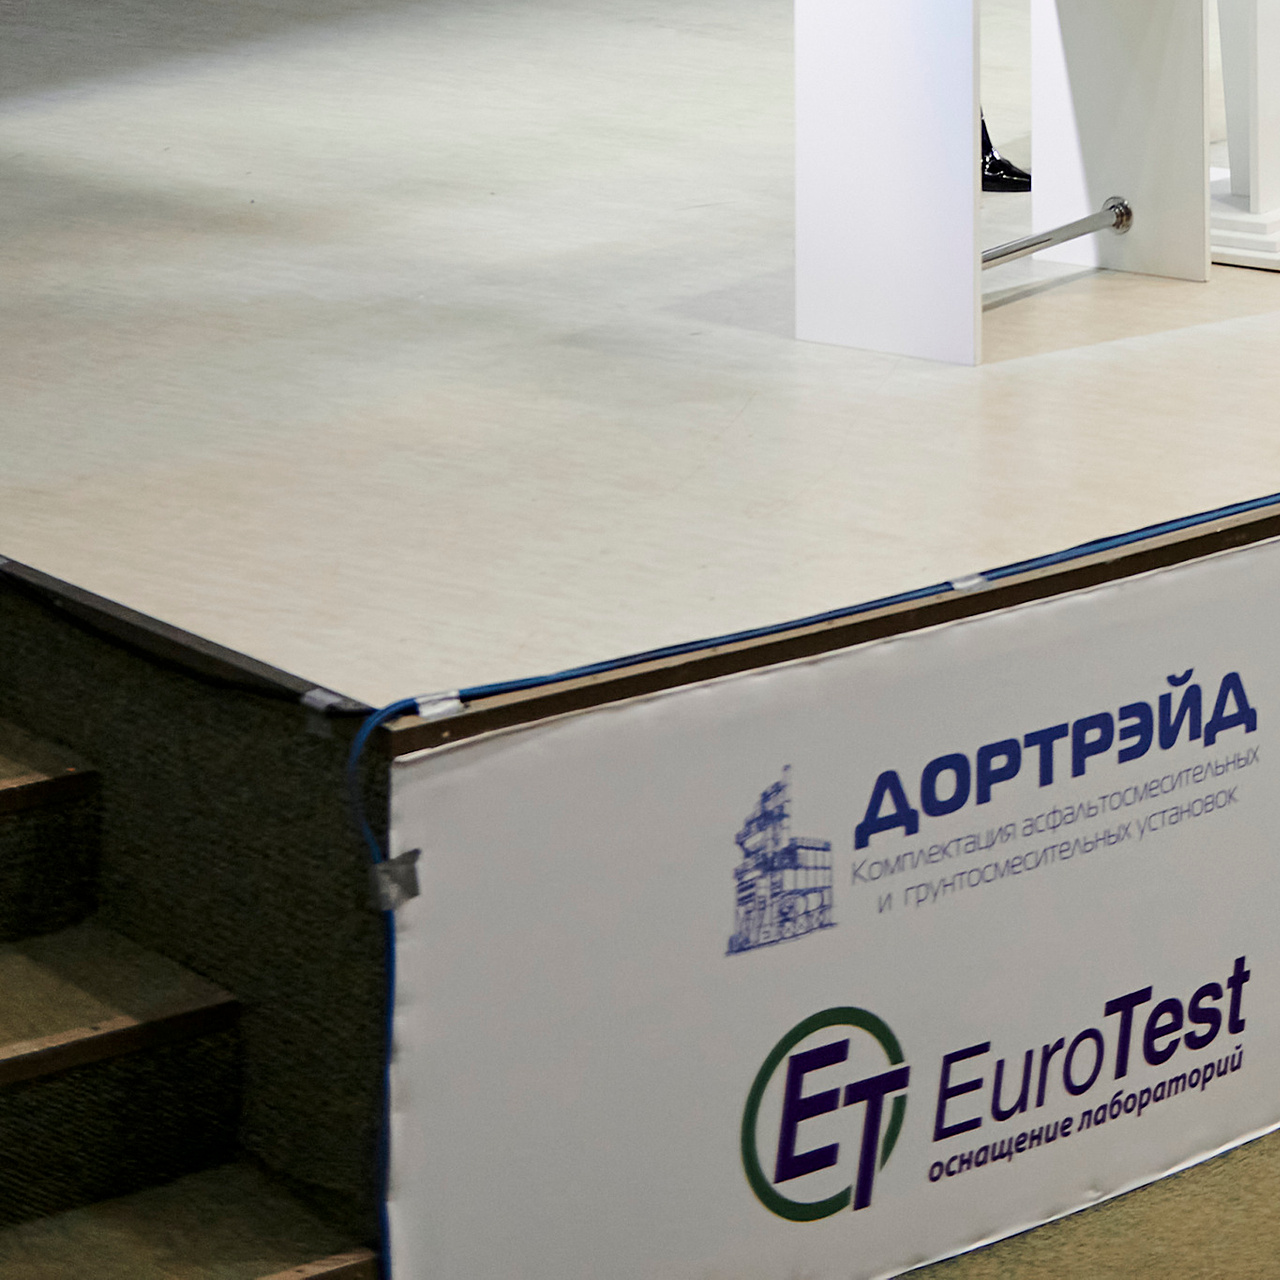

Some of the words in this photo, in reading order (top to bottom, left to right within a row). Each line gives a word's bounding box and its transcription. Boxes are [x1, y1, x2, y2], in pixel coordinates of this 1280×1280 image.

[851, 823, 1017, 886] Комплектация
[1021, 744, 1260, 838] асфальтосмесительных
[853, 667, 1258, 850] ДОРТРЭЙД
[877, 893, 892, 915] и
[904, 820, 1132, 910] грунтосмесительных
[1136, 786, 1239, 840] установок
[929, 1115, 1072, 1183] оснащение
[1077, 1043, 1245, 1131] лабораторий
[932, 954, 1251, 1143] EuroTest
